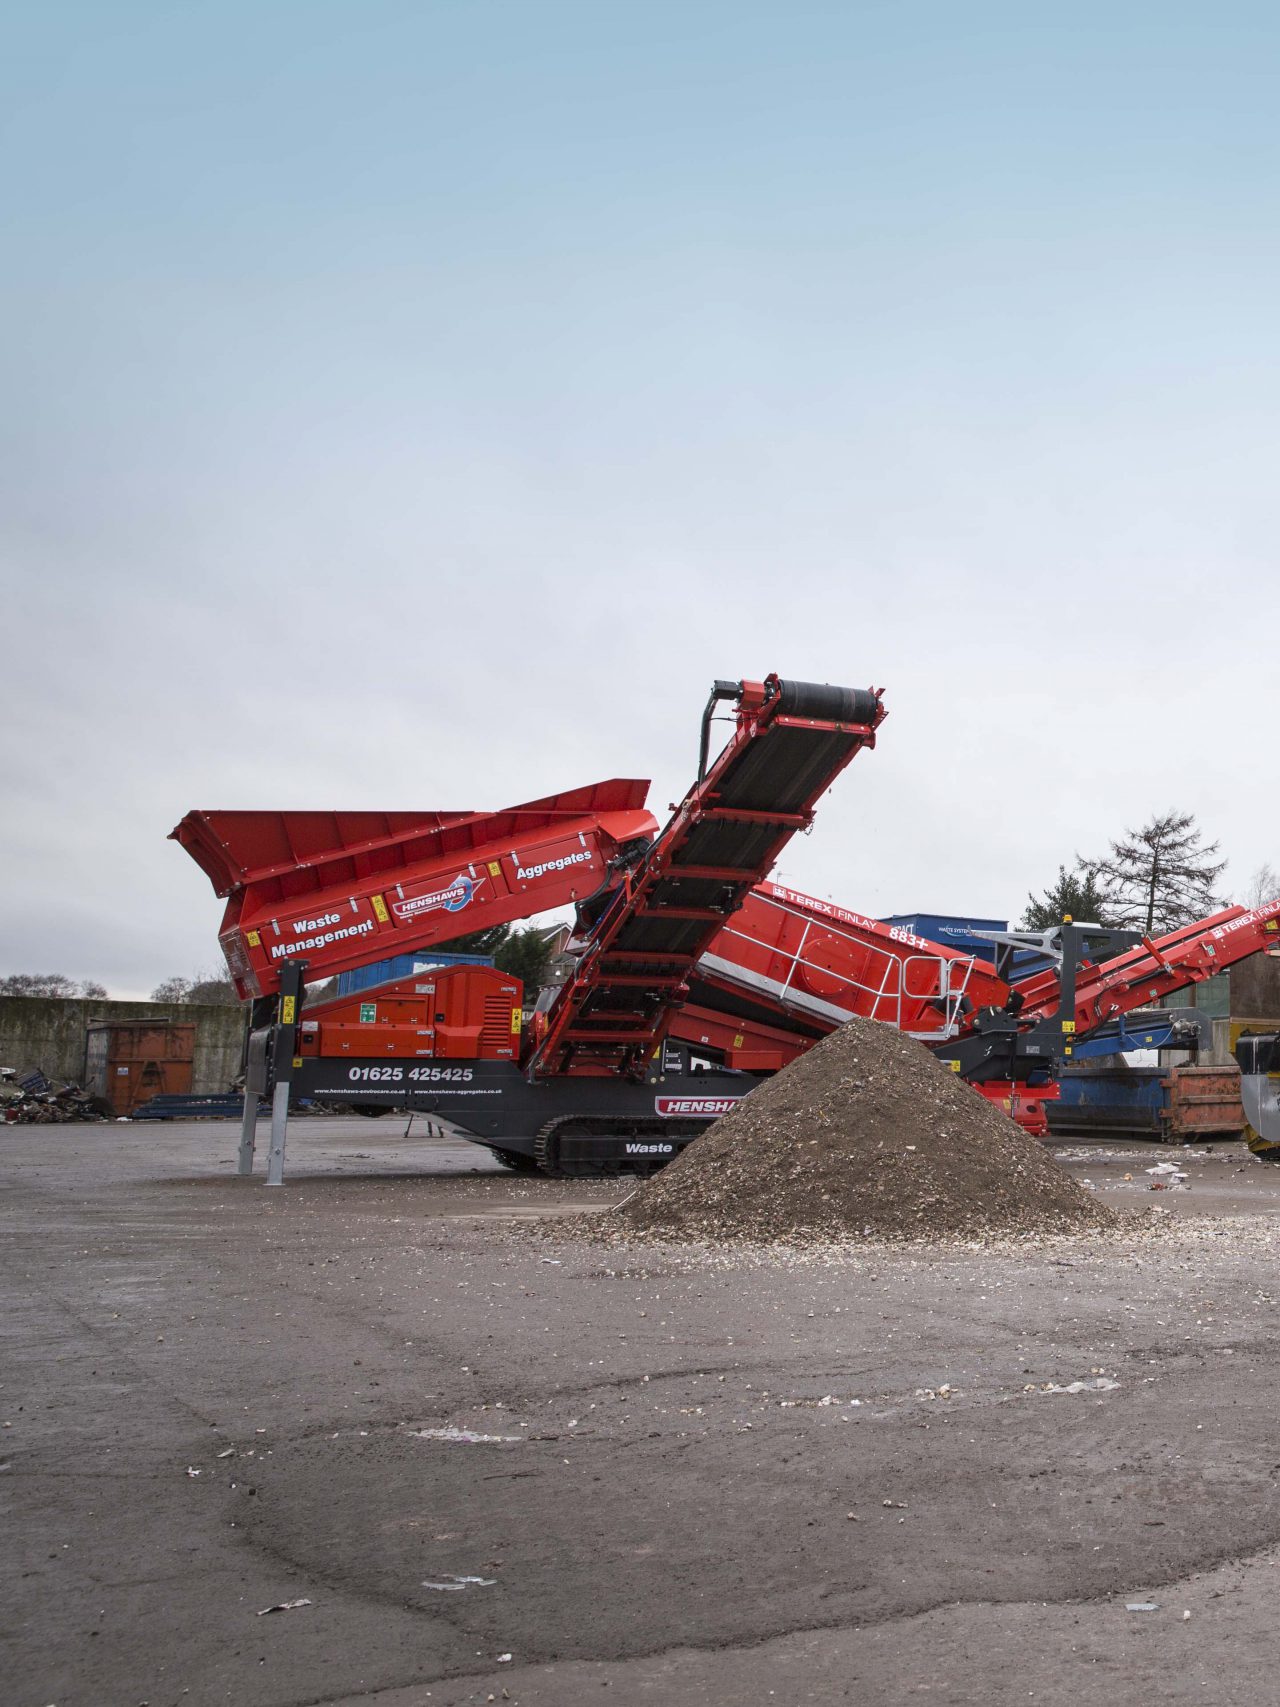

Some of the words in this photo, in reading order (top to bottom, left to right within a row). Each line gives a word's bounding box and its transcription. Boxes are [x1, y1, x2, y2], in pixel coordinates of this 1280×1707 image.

[516, 850, 592, 879] Aggregates
[402, 887, 465, 912] HENSHAWS
[788, 891, 832, 914] TEREX
[838, 909, 877, 930] FINLAY
[293, 913, 341, 934] Waste
[1222, 913, 1257, 933] TEREX
[271, 919, 374, 958] Management
[889, 927, 929, 949] 883+
[348, 1067, 403, 1080] 01625
[408, 1067, 473, 1081] 425425
[625, 1143, 673, 1153] Waste
